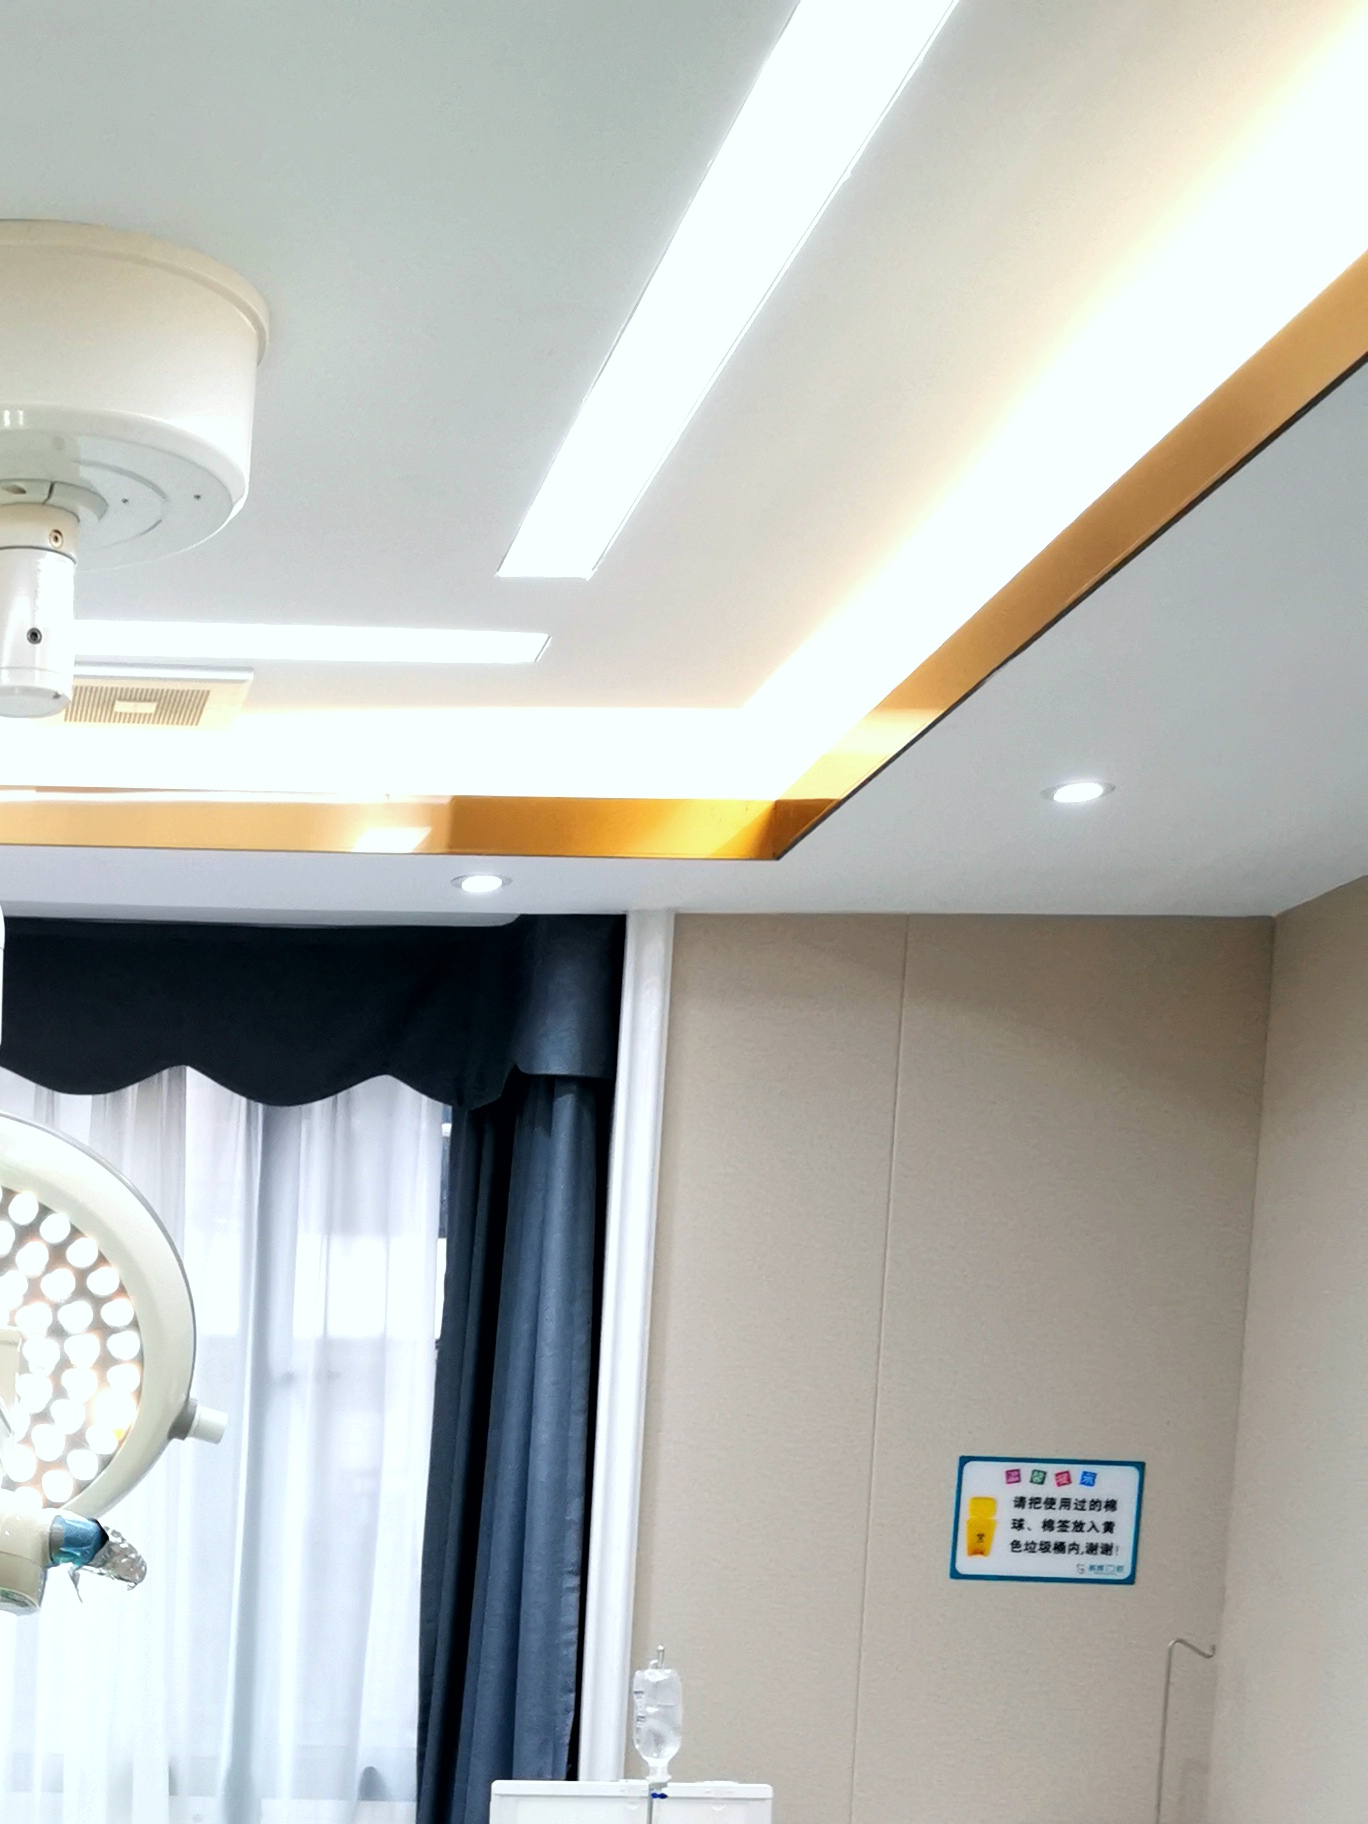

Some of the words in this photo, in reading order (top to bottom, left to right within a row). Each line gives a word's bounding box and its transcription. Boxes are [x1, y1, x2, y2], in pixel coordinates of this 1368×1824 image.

[1012, 1496, 1118, 1513] 请把使用过的棉
[1011, 1518, 1116, 1535] 球、棉签放入黄
